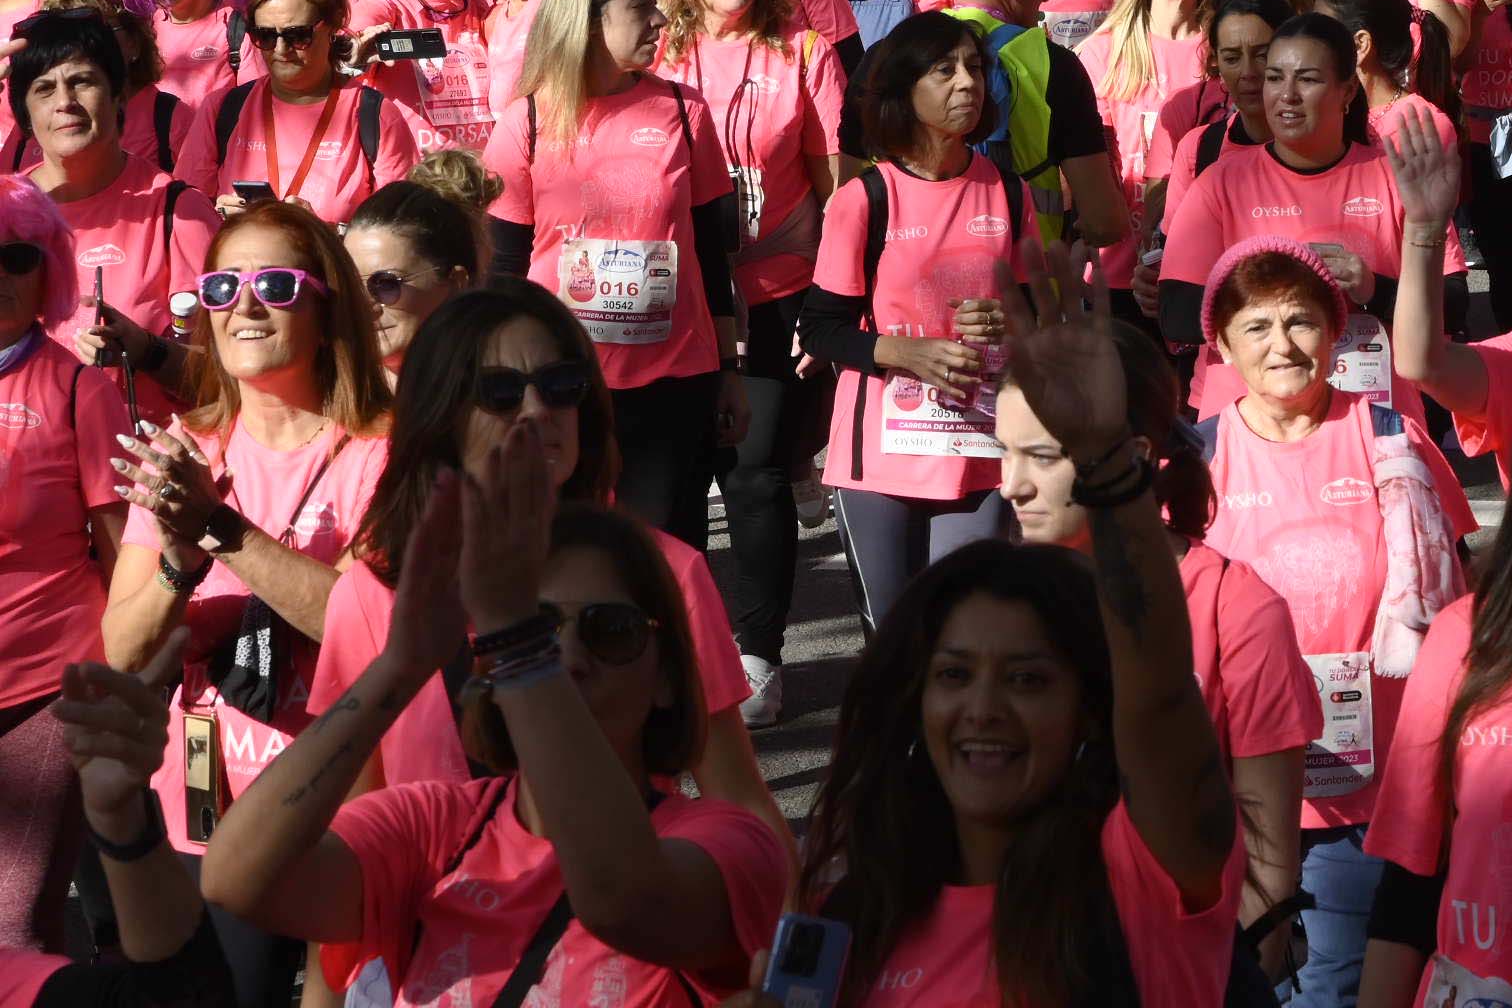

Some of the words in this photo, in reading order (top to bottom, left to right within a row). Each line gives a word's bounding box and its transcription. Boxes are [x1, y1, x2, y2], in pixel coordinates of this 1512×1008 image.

[446, 74, 469, 87] 016
[418, 123, 491, 148] DORSA
[1251, 205, 1302, 218] OYSHO
[885, 225, 929, 242] YSHO
[600, 281, 639, 297] 016
[603, 300, 634, 311] 30542
[576, 311, 604, 320] CARRERA
[616, 313, 625, 321] LA
[898, 421, 932, 430] CARRERA
[933, 423, 944, 431] DE
[945, 423, 955, 431] LA
[1329, 672, 1359, 682] SUMA
[1313, 775, 1363, 787] Santander
[1451, 898, 1497, 951] TU
